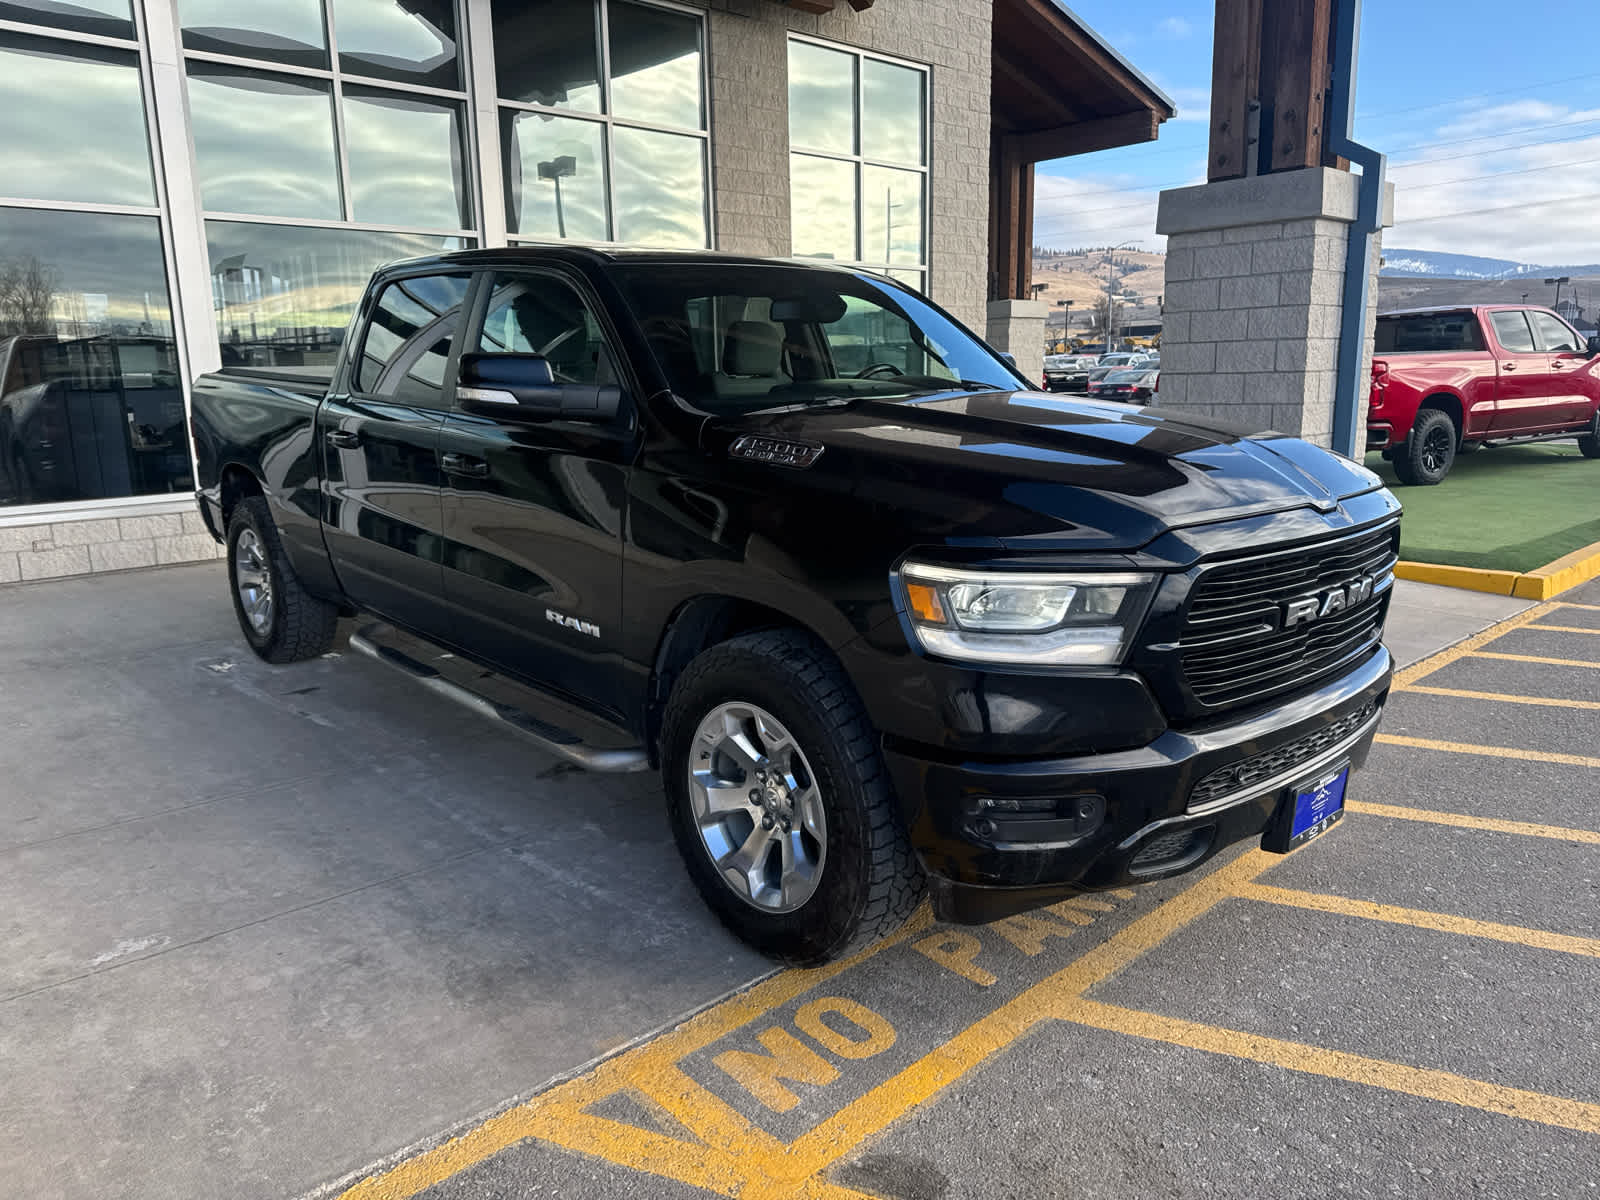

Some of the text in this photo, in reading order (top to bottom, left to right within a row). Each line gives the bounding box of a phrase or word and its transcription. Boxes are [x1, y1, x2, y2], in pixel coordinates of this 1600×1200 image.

[546, 608, 600, 639] RAM
[1284, 576, 1372, 627] RAM
[711, 996, 897, 1113] NO
